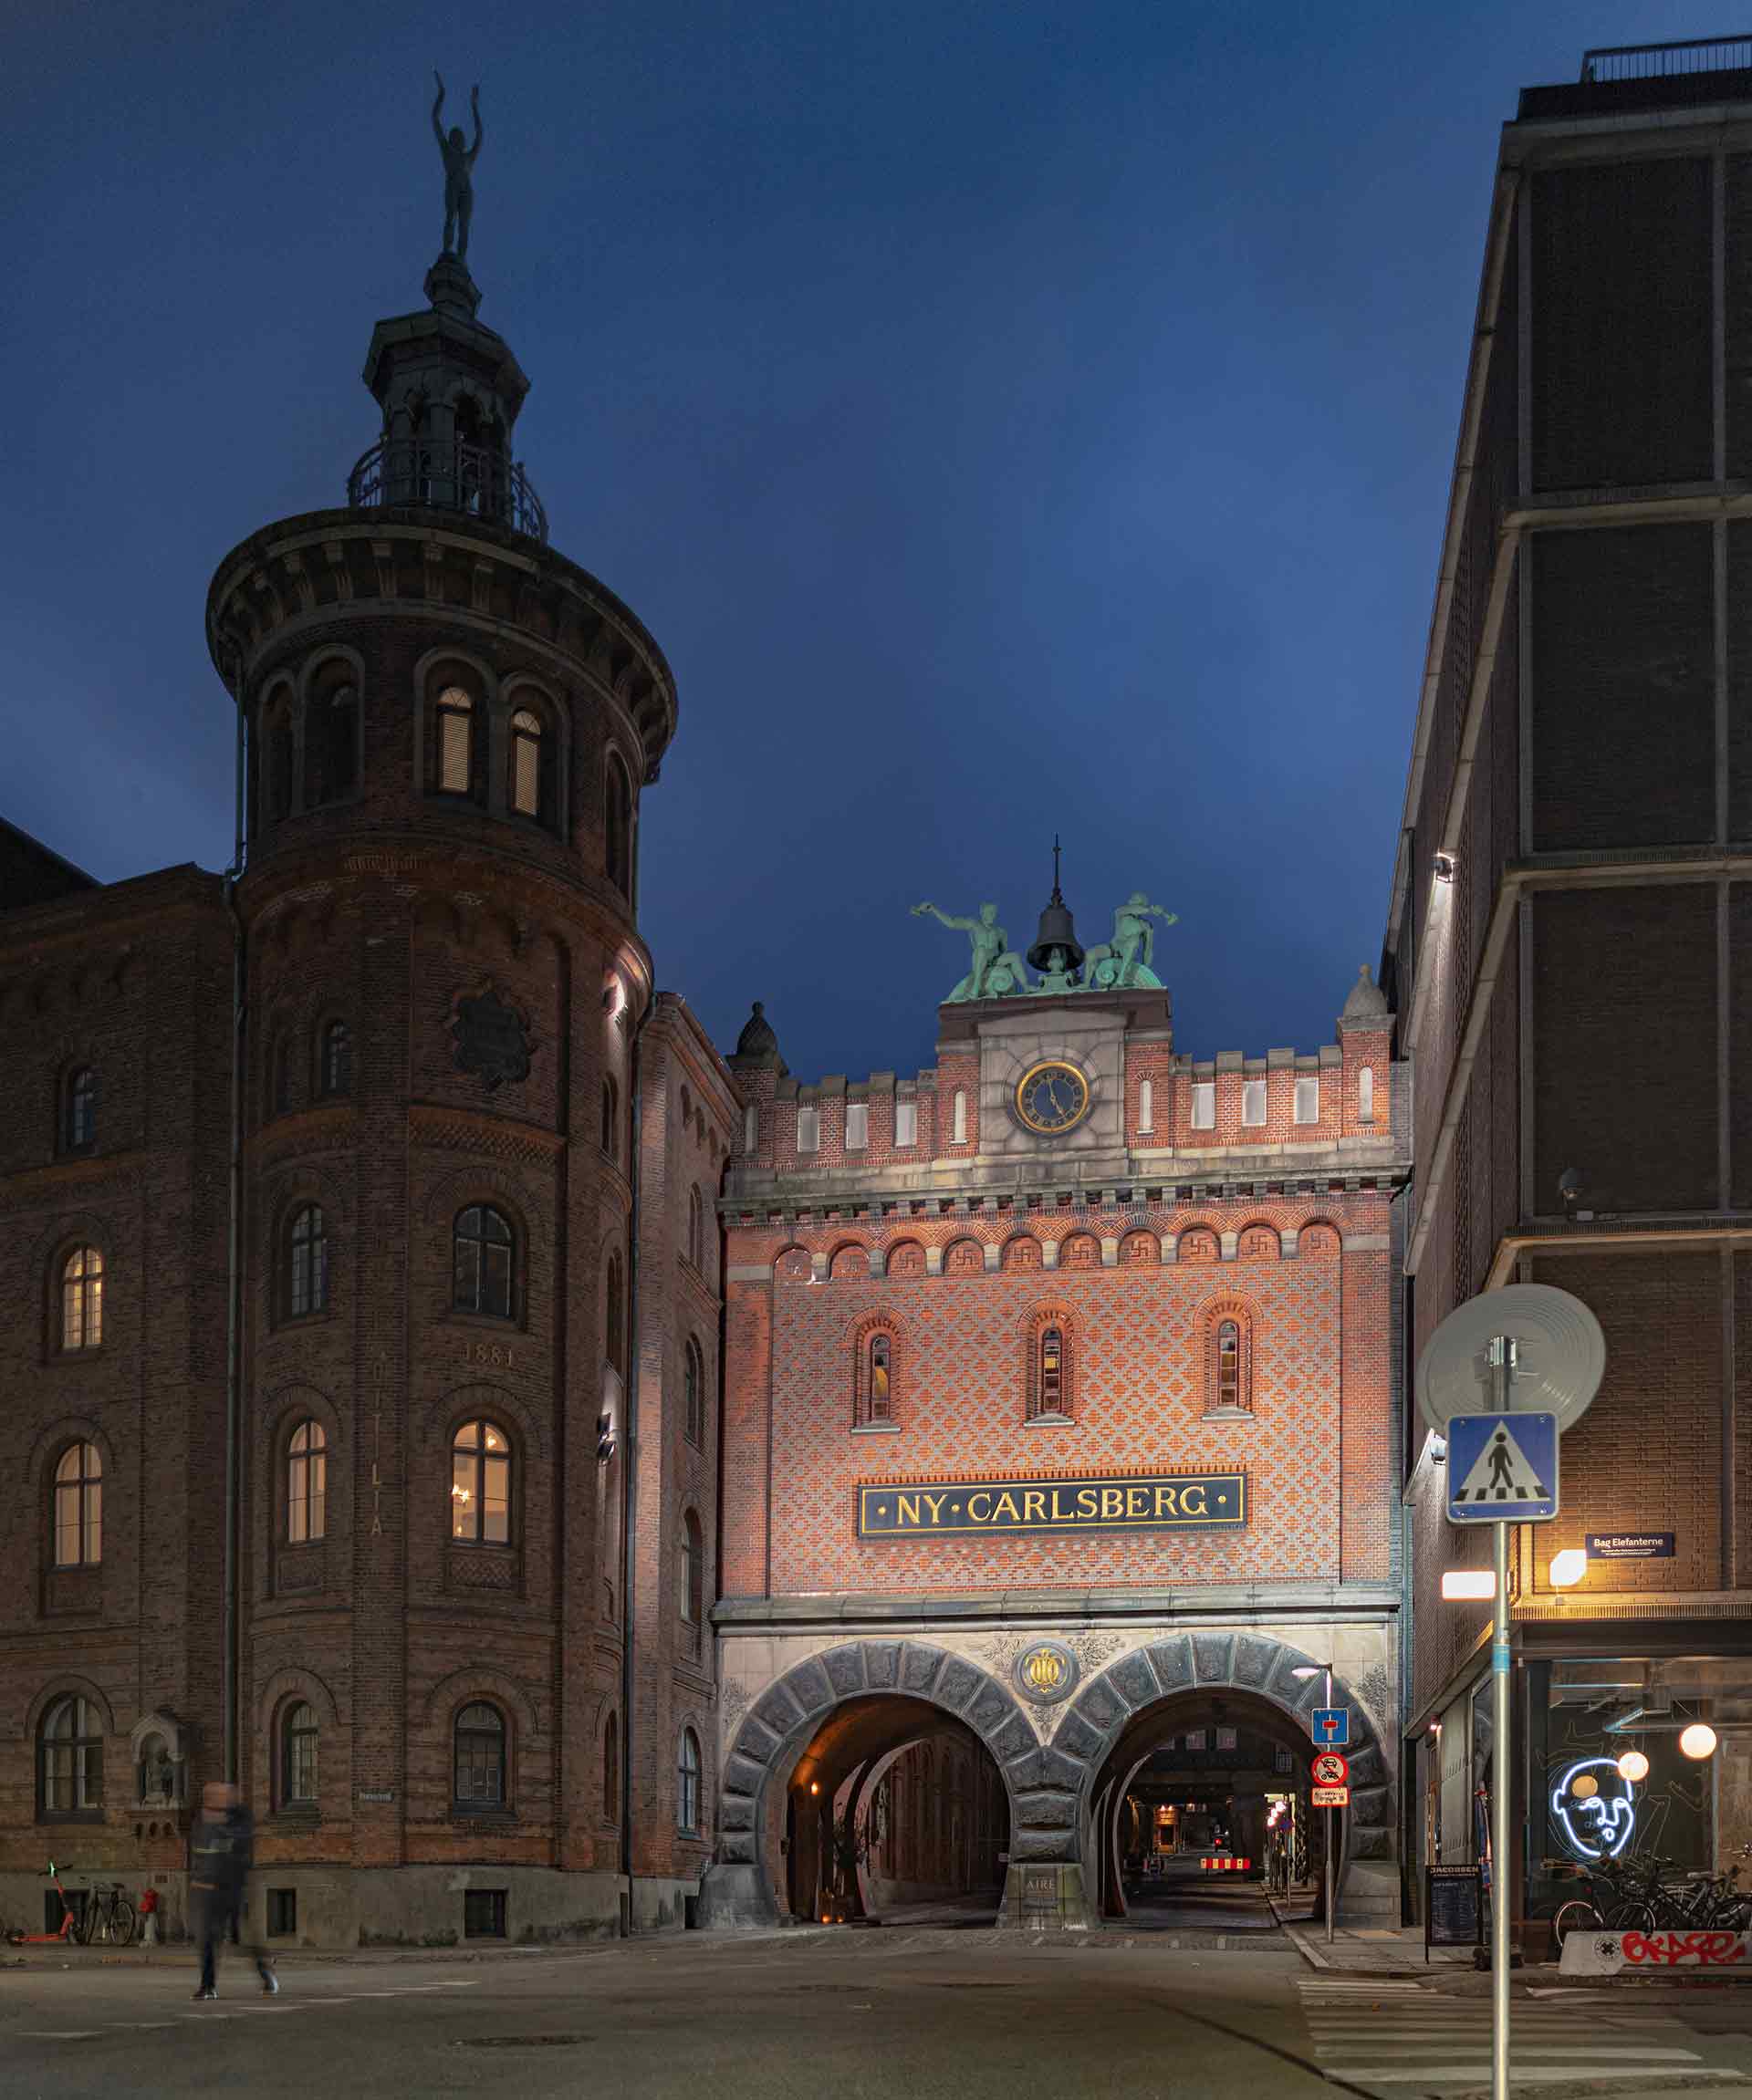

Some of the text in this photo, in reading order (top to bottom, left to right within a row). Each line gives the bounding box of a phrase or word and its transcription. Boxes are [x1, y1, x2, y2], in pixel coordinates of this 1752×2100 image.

[897, 1486, 1208, 1524] NY CARLSBERG
[1594, 1537, 1663, 1548] Bag Elefanterne
